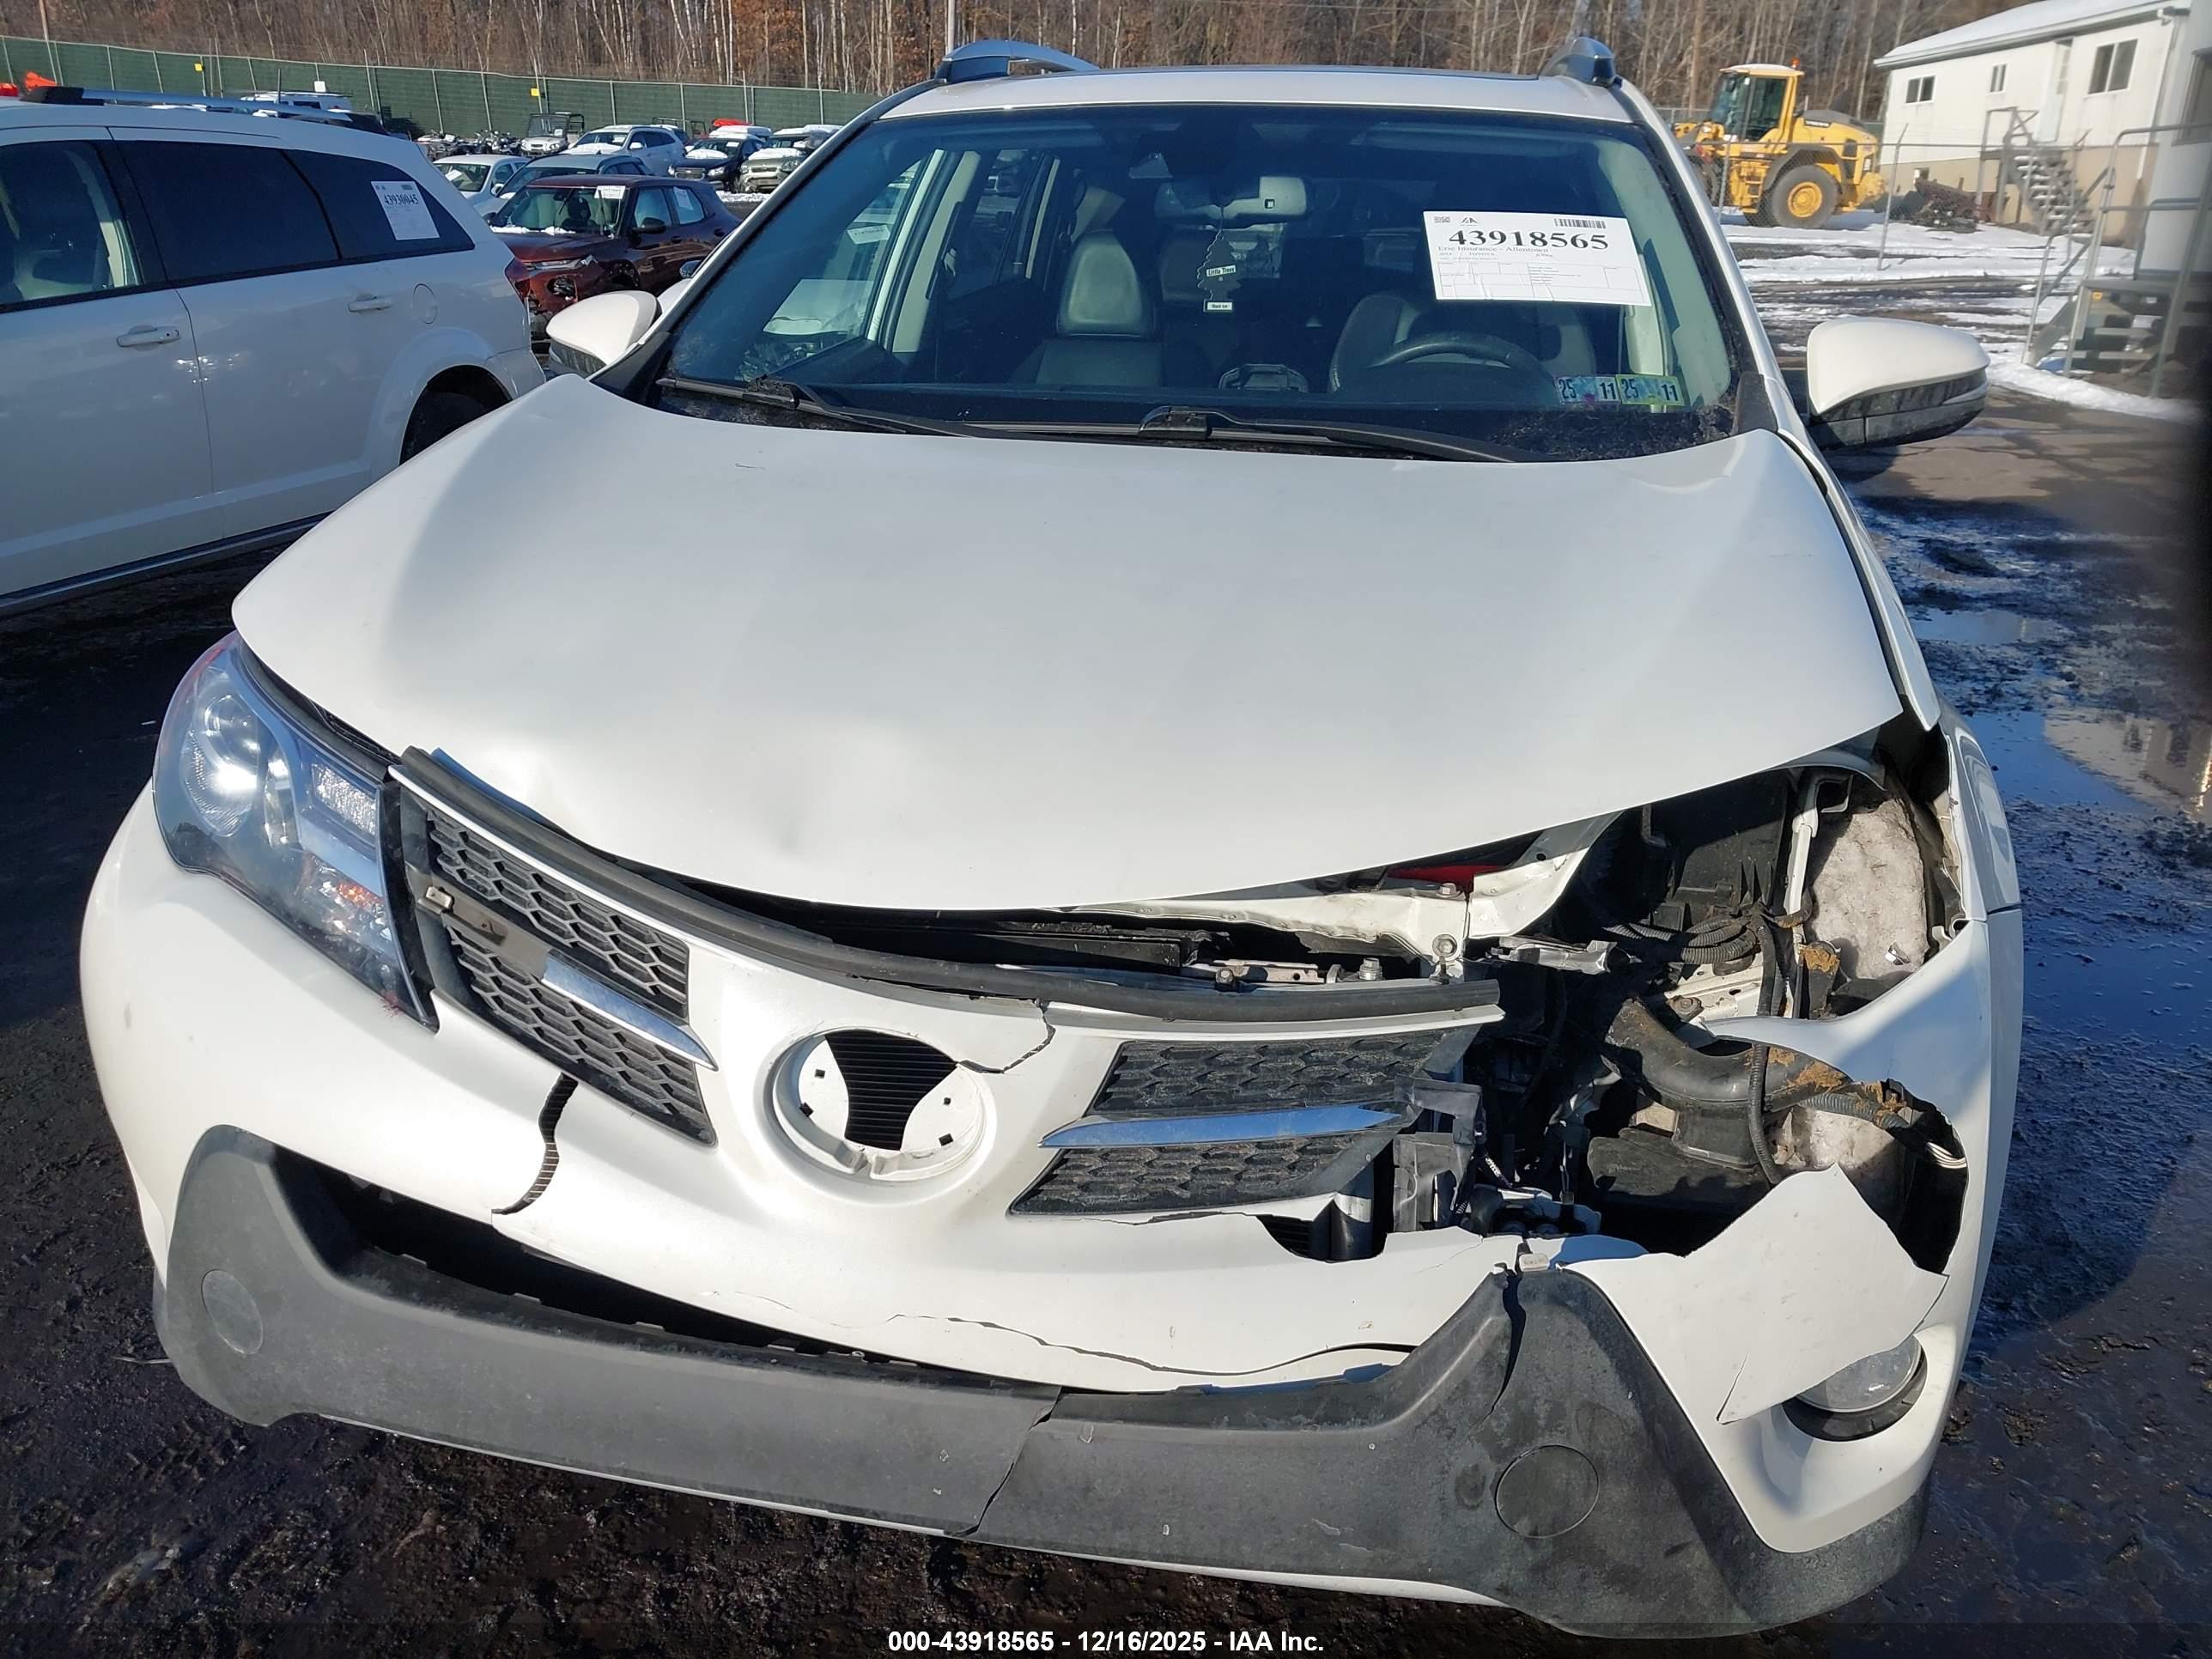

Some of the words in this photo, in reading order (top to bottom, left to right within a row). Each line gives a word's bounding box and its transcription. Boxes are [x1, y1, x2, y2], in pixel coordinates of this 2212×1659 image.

[1449, 229, 1608, 250] 43918565
[1559, 379, 1577, 399] 25
[1599, 382, 1617, 400] 11
[1621, 379, 1639, 399] 25
[1661, 384, 1679, 401] 11
